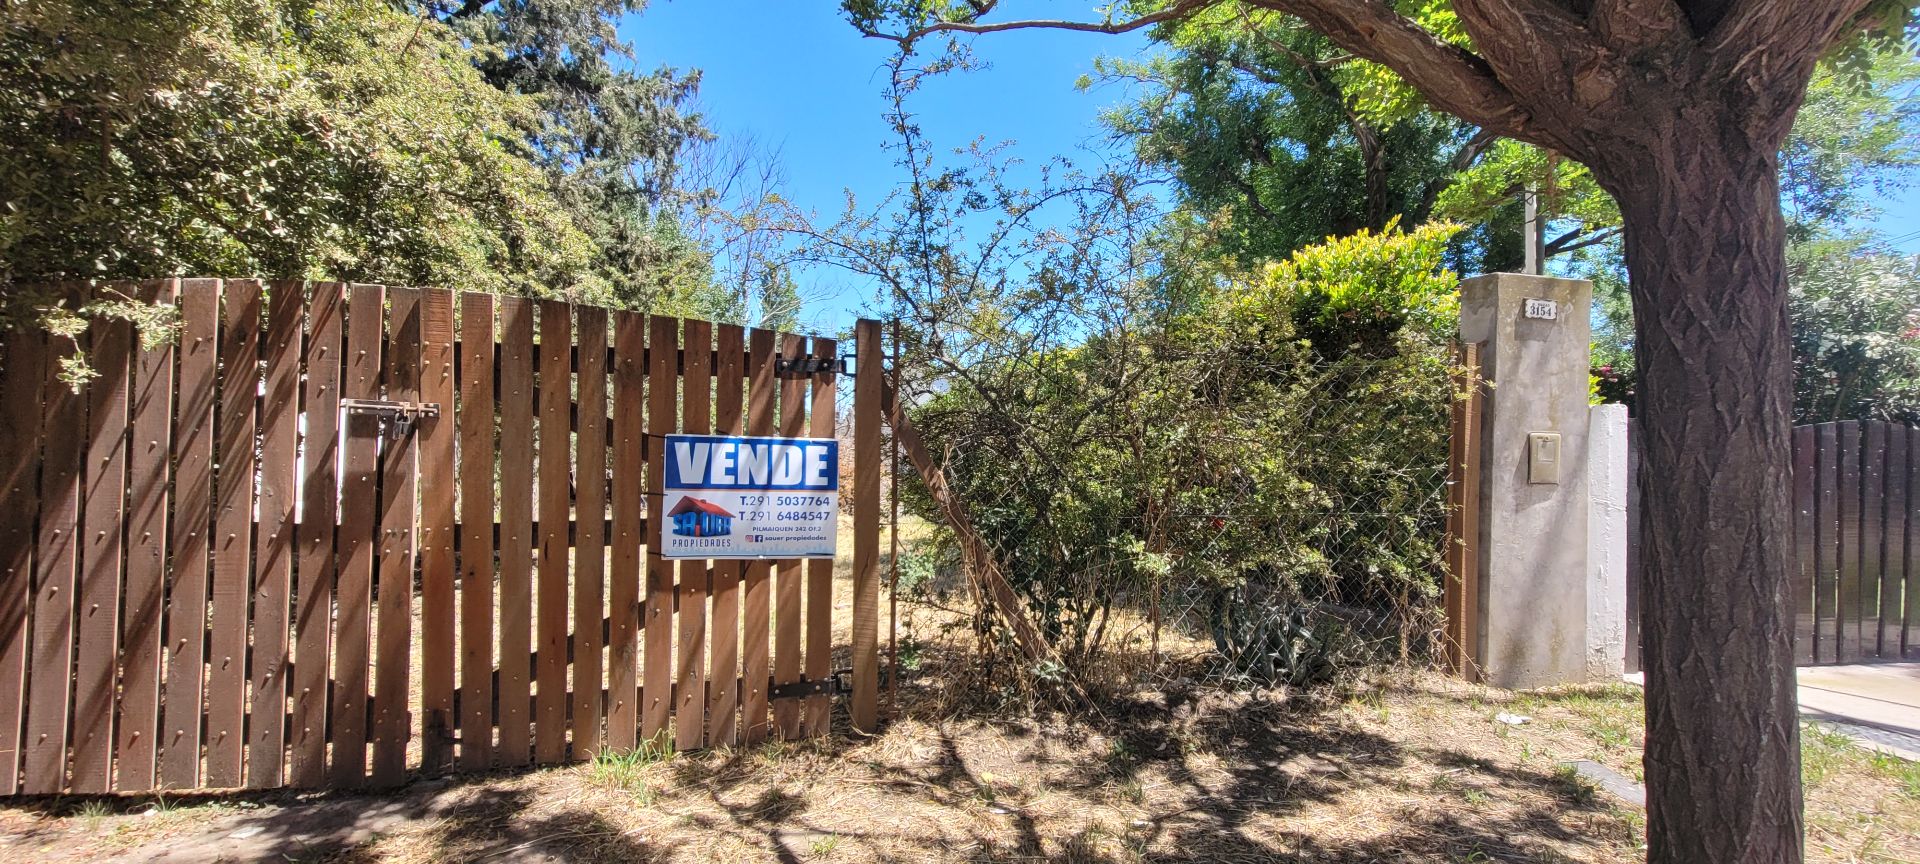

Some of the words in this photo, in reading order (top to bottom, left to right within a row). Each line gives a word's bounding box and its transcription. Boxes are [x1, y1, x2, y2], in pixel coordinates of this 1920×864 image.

[1530, 306, 1551, 316] 3154
[674, 441, 829, 486] VENDE
[740, 496, 770, 506] T.291
[777, 496, 830, 506] 5037764
[739, 511, 770, 521] T.291
[777, 511, 830, 521] 6484547
[672, 539, 731, 547] PROPIEDADES
